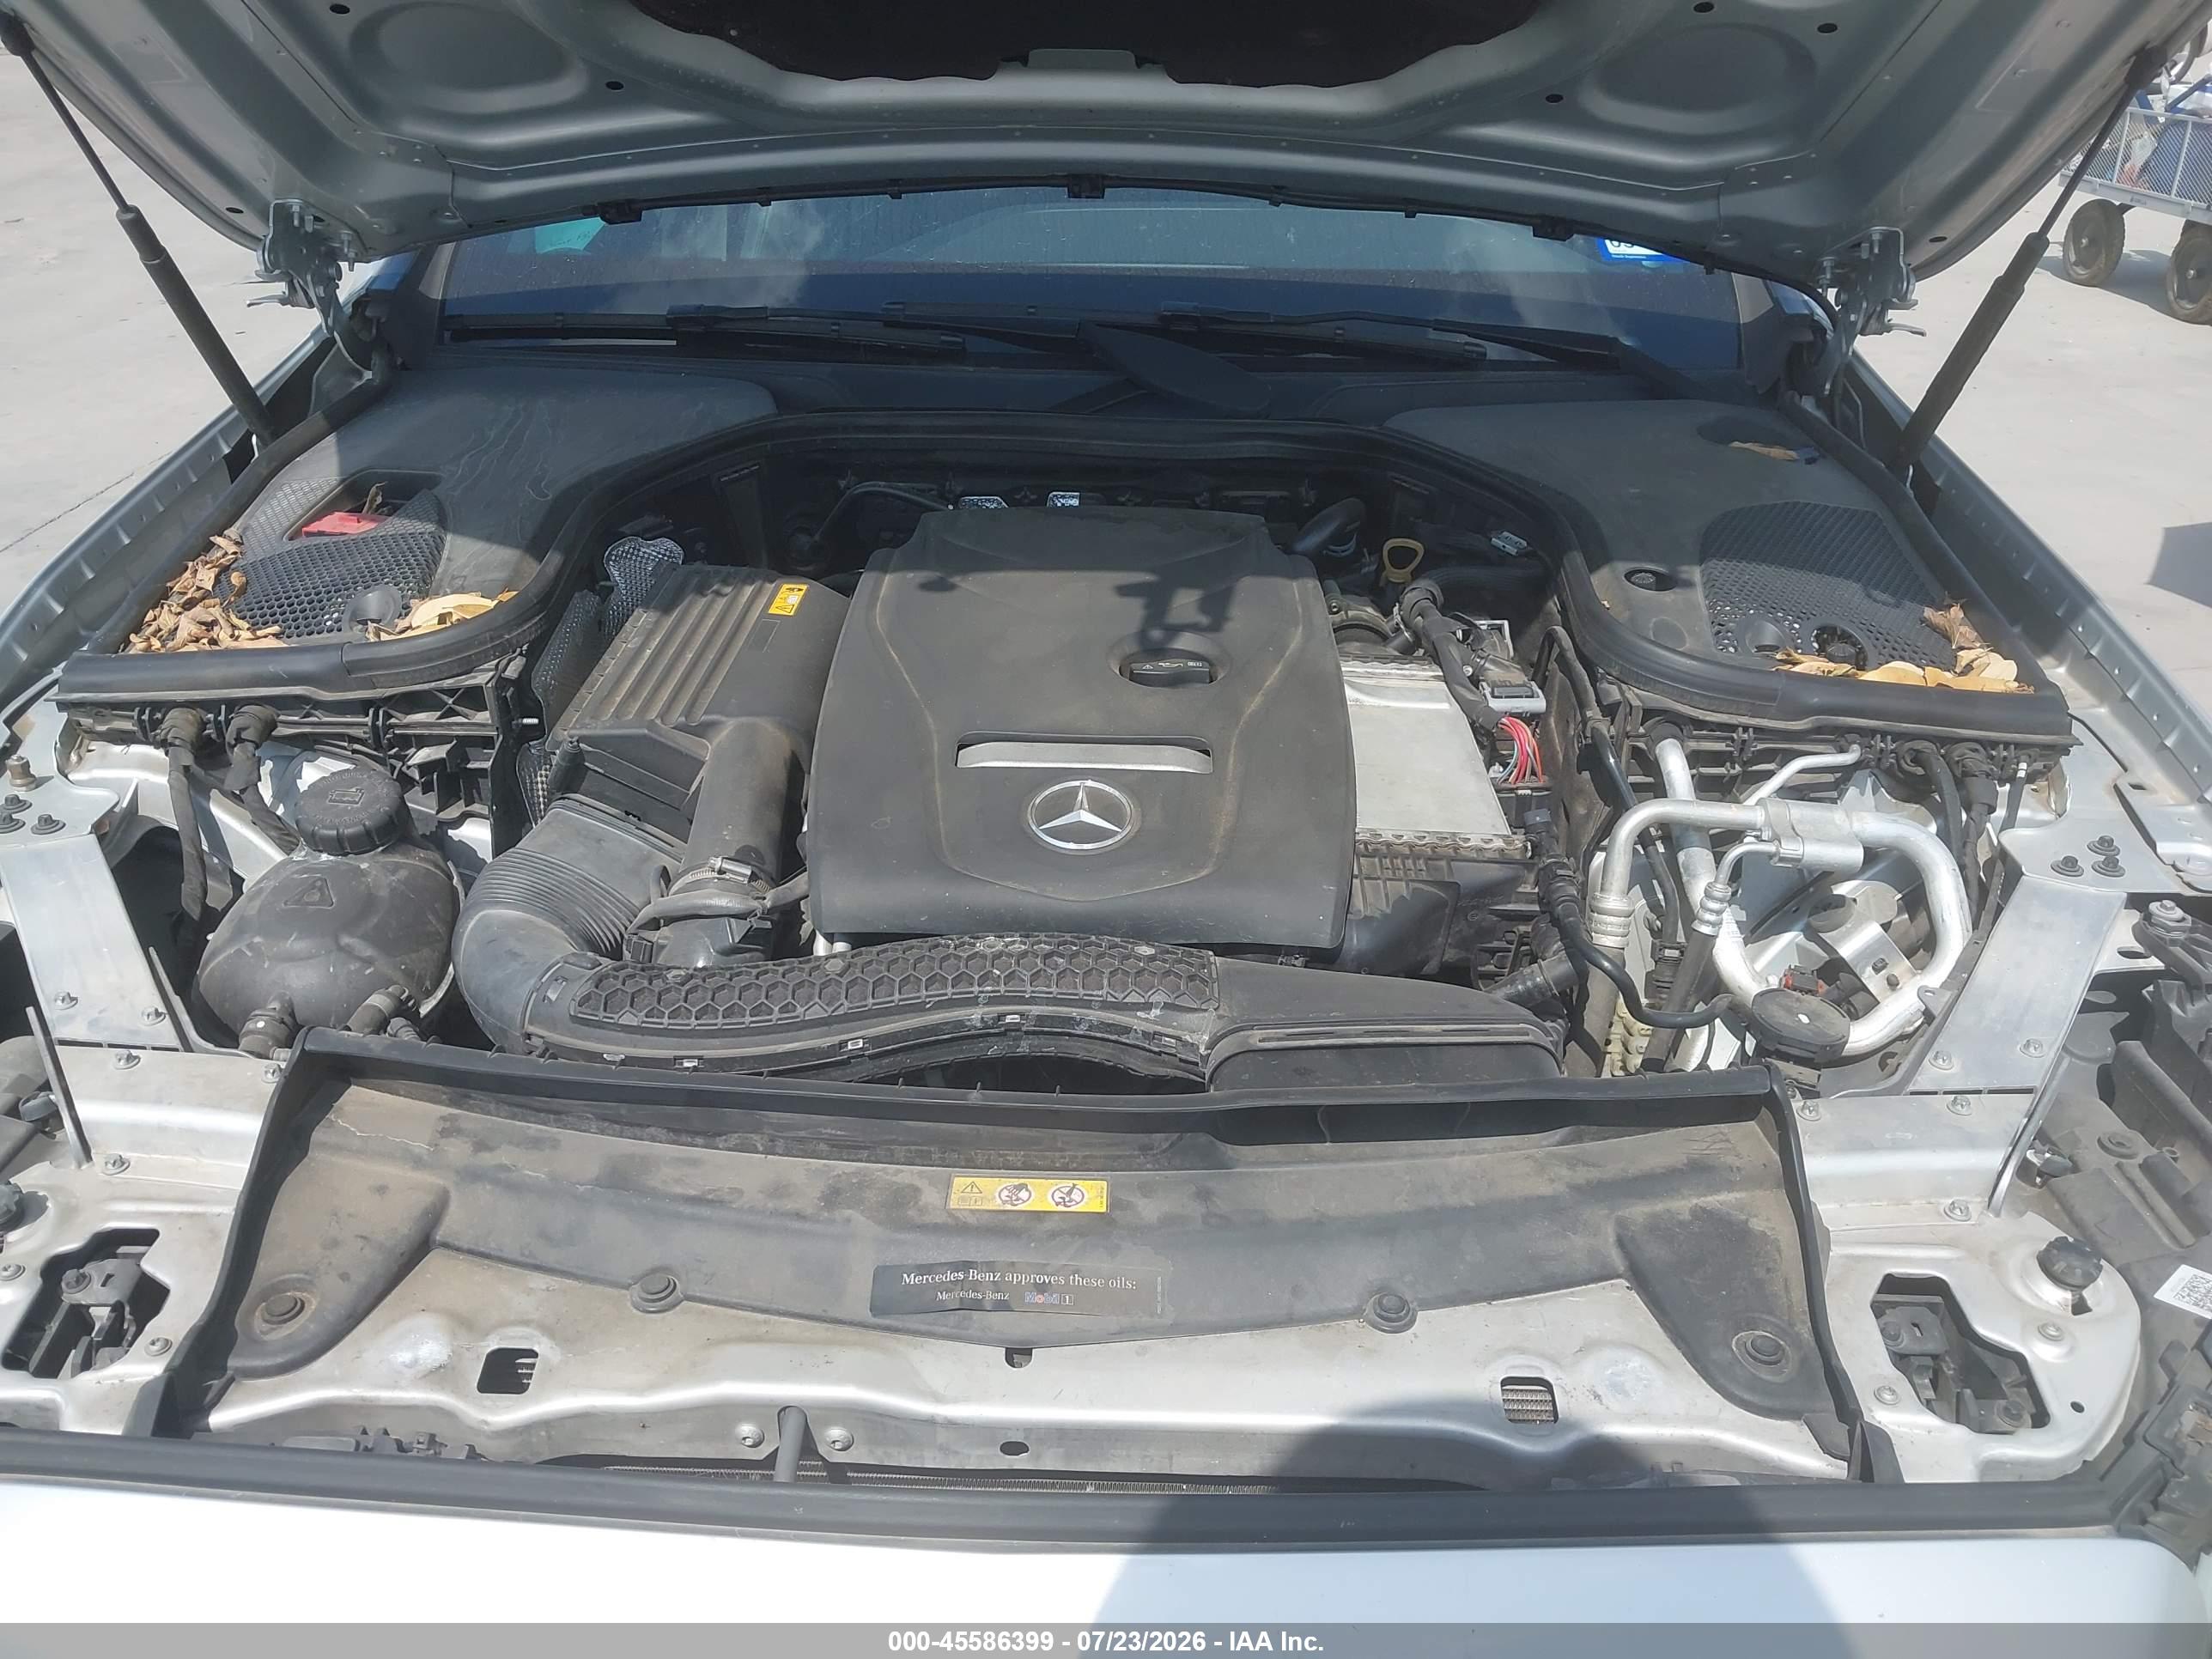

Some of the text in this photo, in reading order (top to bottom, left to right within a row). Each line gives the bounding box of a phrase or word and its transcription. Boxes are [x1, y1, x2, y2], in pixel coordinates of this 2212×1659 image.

[902, 1269, 1137, 1290] Mercedes-Benz approves these oils:
[936, 1289, 1010, 1301] Mercedes-Benz
[1024, 1291, 1060, 1304] Mobil
